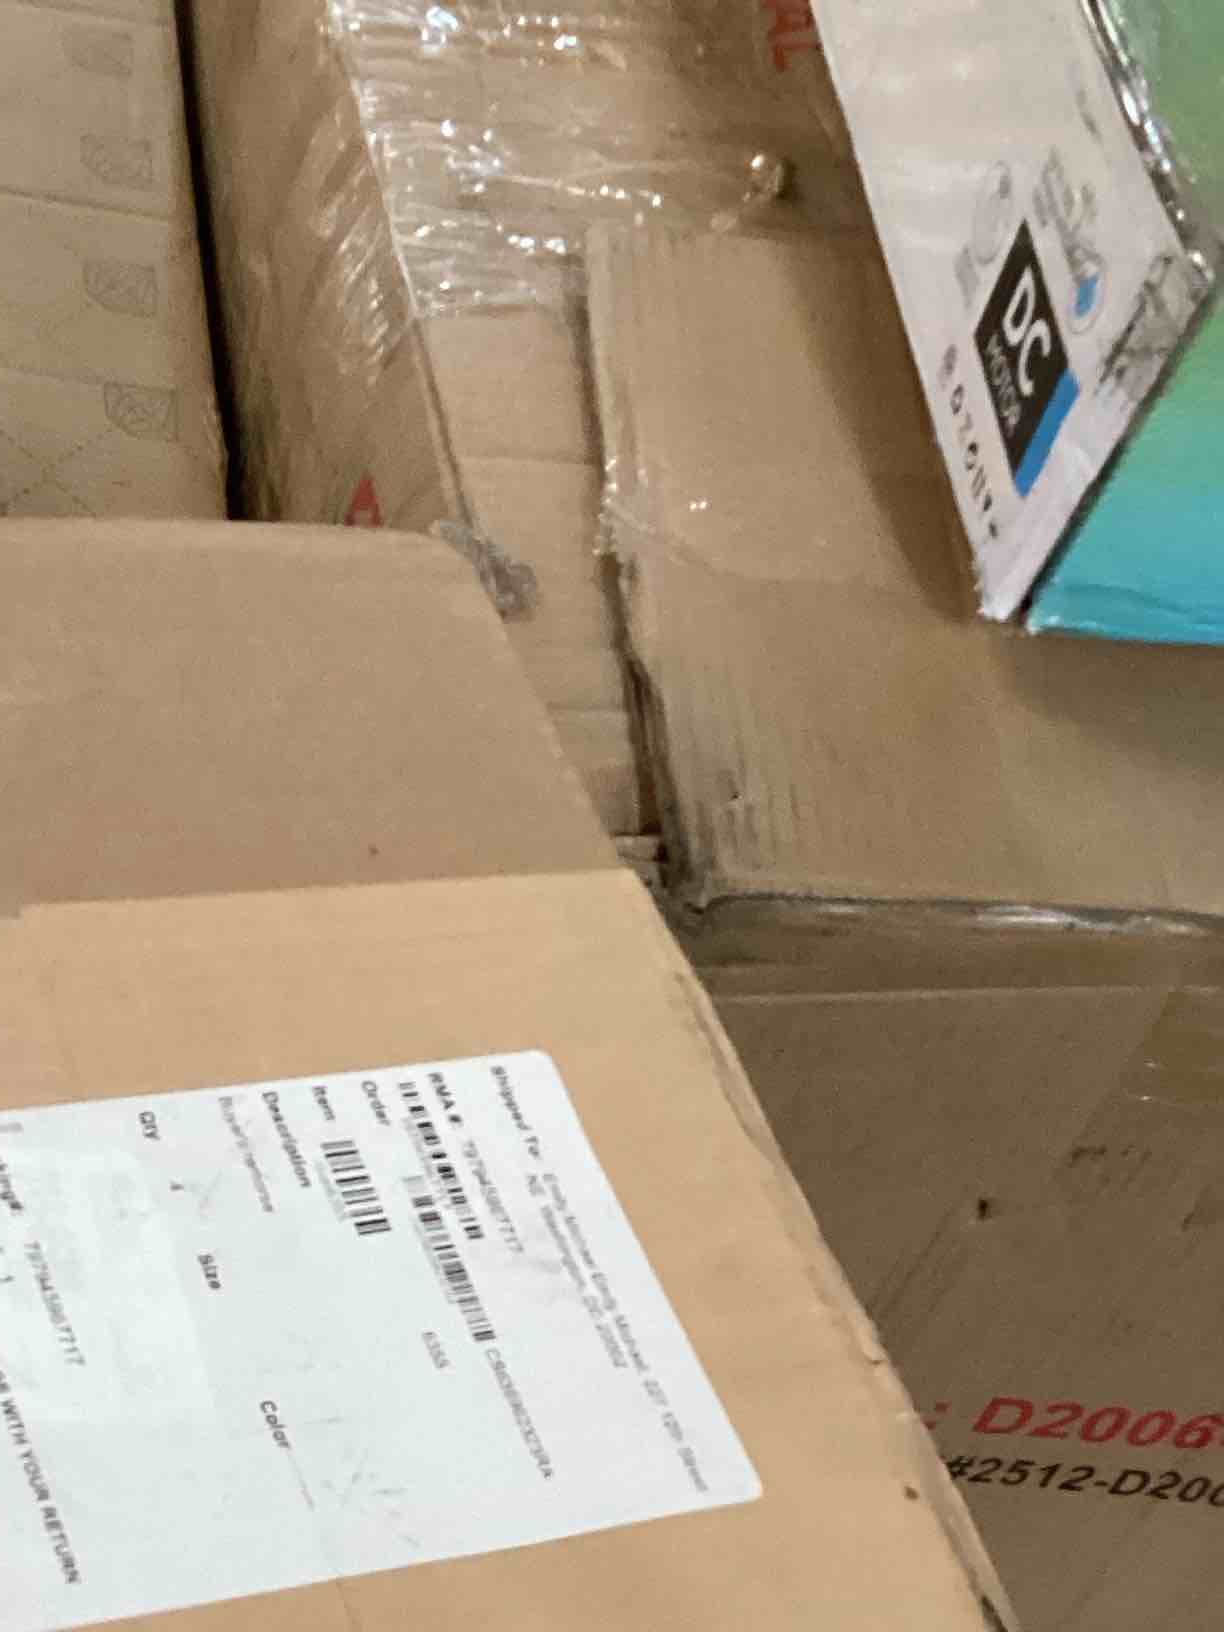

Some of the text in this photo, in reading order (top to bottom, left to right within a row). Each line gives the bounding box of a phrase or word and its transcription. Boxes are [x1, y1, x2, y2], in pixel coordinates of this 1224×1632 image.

[1003, 267, 1055, 398] DC
[361, 1080, 391, 1126] Order
[428, 1072, 455, 1111] RMA
[138, 1111, 161, 1141] Qty
[261, 1091, 312, 1188] Description
[197, 1253, 222, 1291] Size
[259, 1400, 291, 1450] Color
[972, 1394, 1224, 1450] D2006
[0, 1399, 29, 1446] WITH
[19, 1449, 51, 1502] YOUR
[40, 1506, 79, 1585] RETURN
